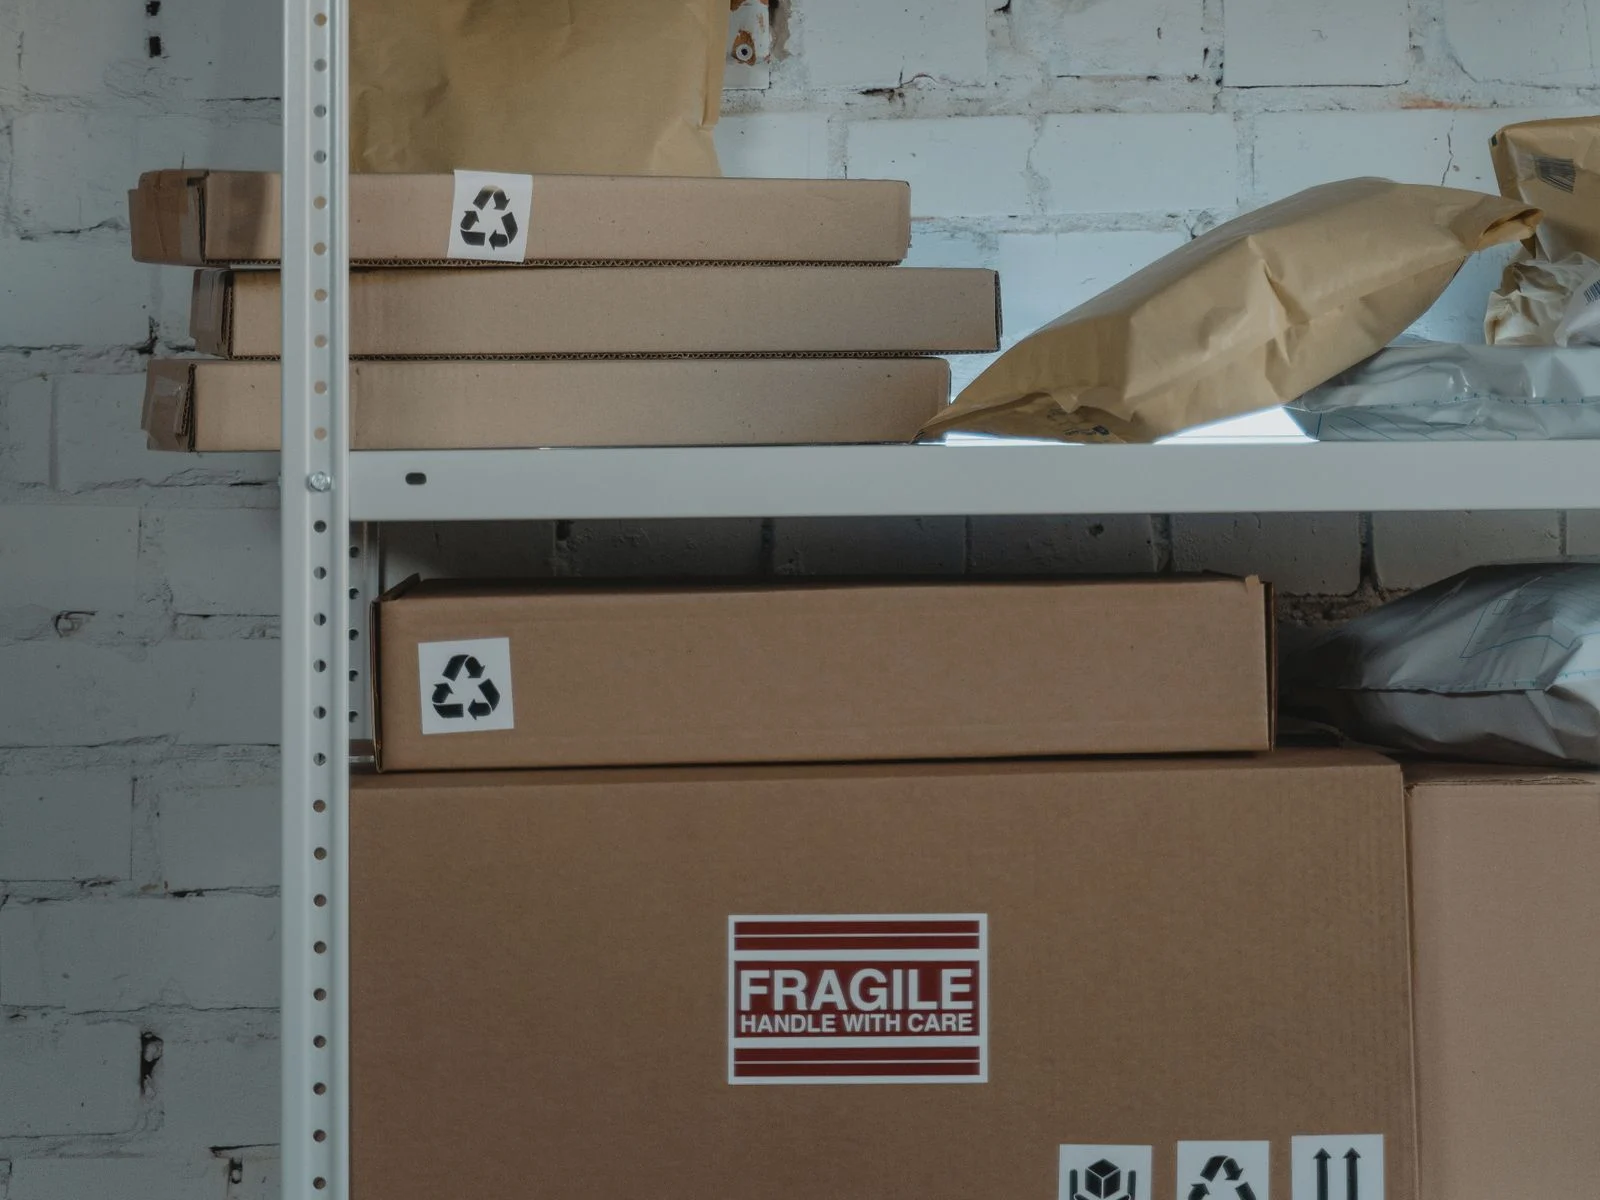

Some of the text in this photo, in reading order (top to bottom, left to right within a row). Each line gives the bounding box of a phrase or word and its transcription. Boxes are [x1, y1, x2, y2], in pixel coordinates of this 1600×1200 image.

[740, 968, 973, 1011] FRAGILE
[740, 1013, 973, 1033] HANDLE WITH CARE
